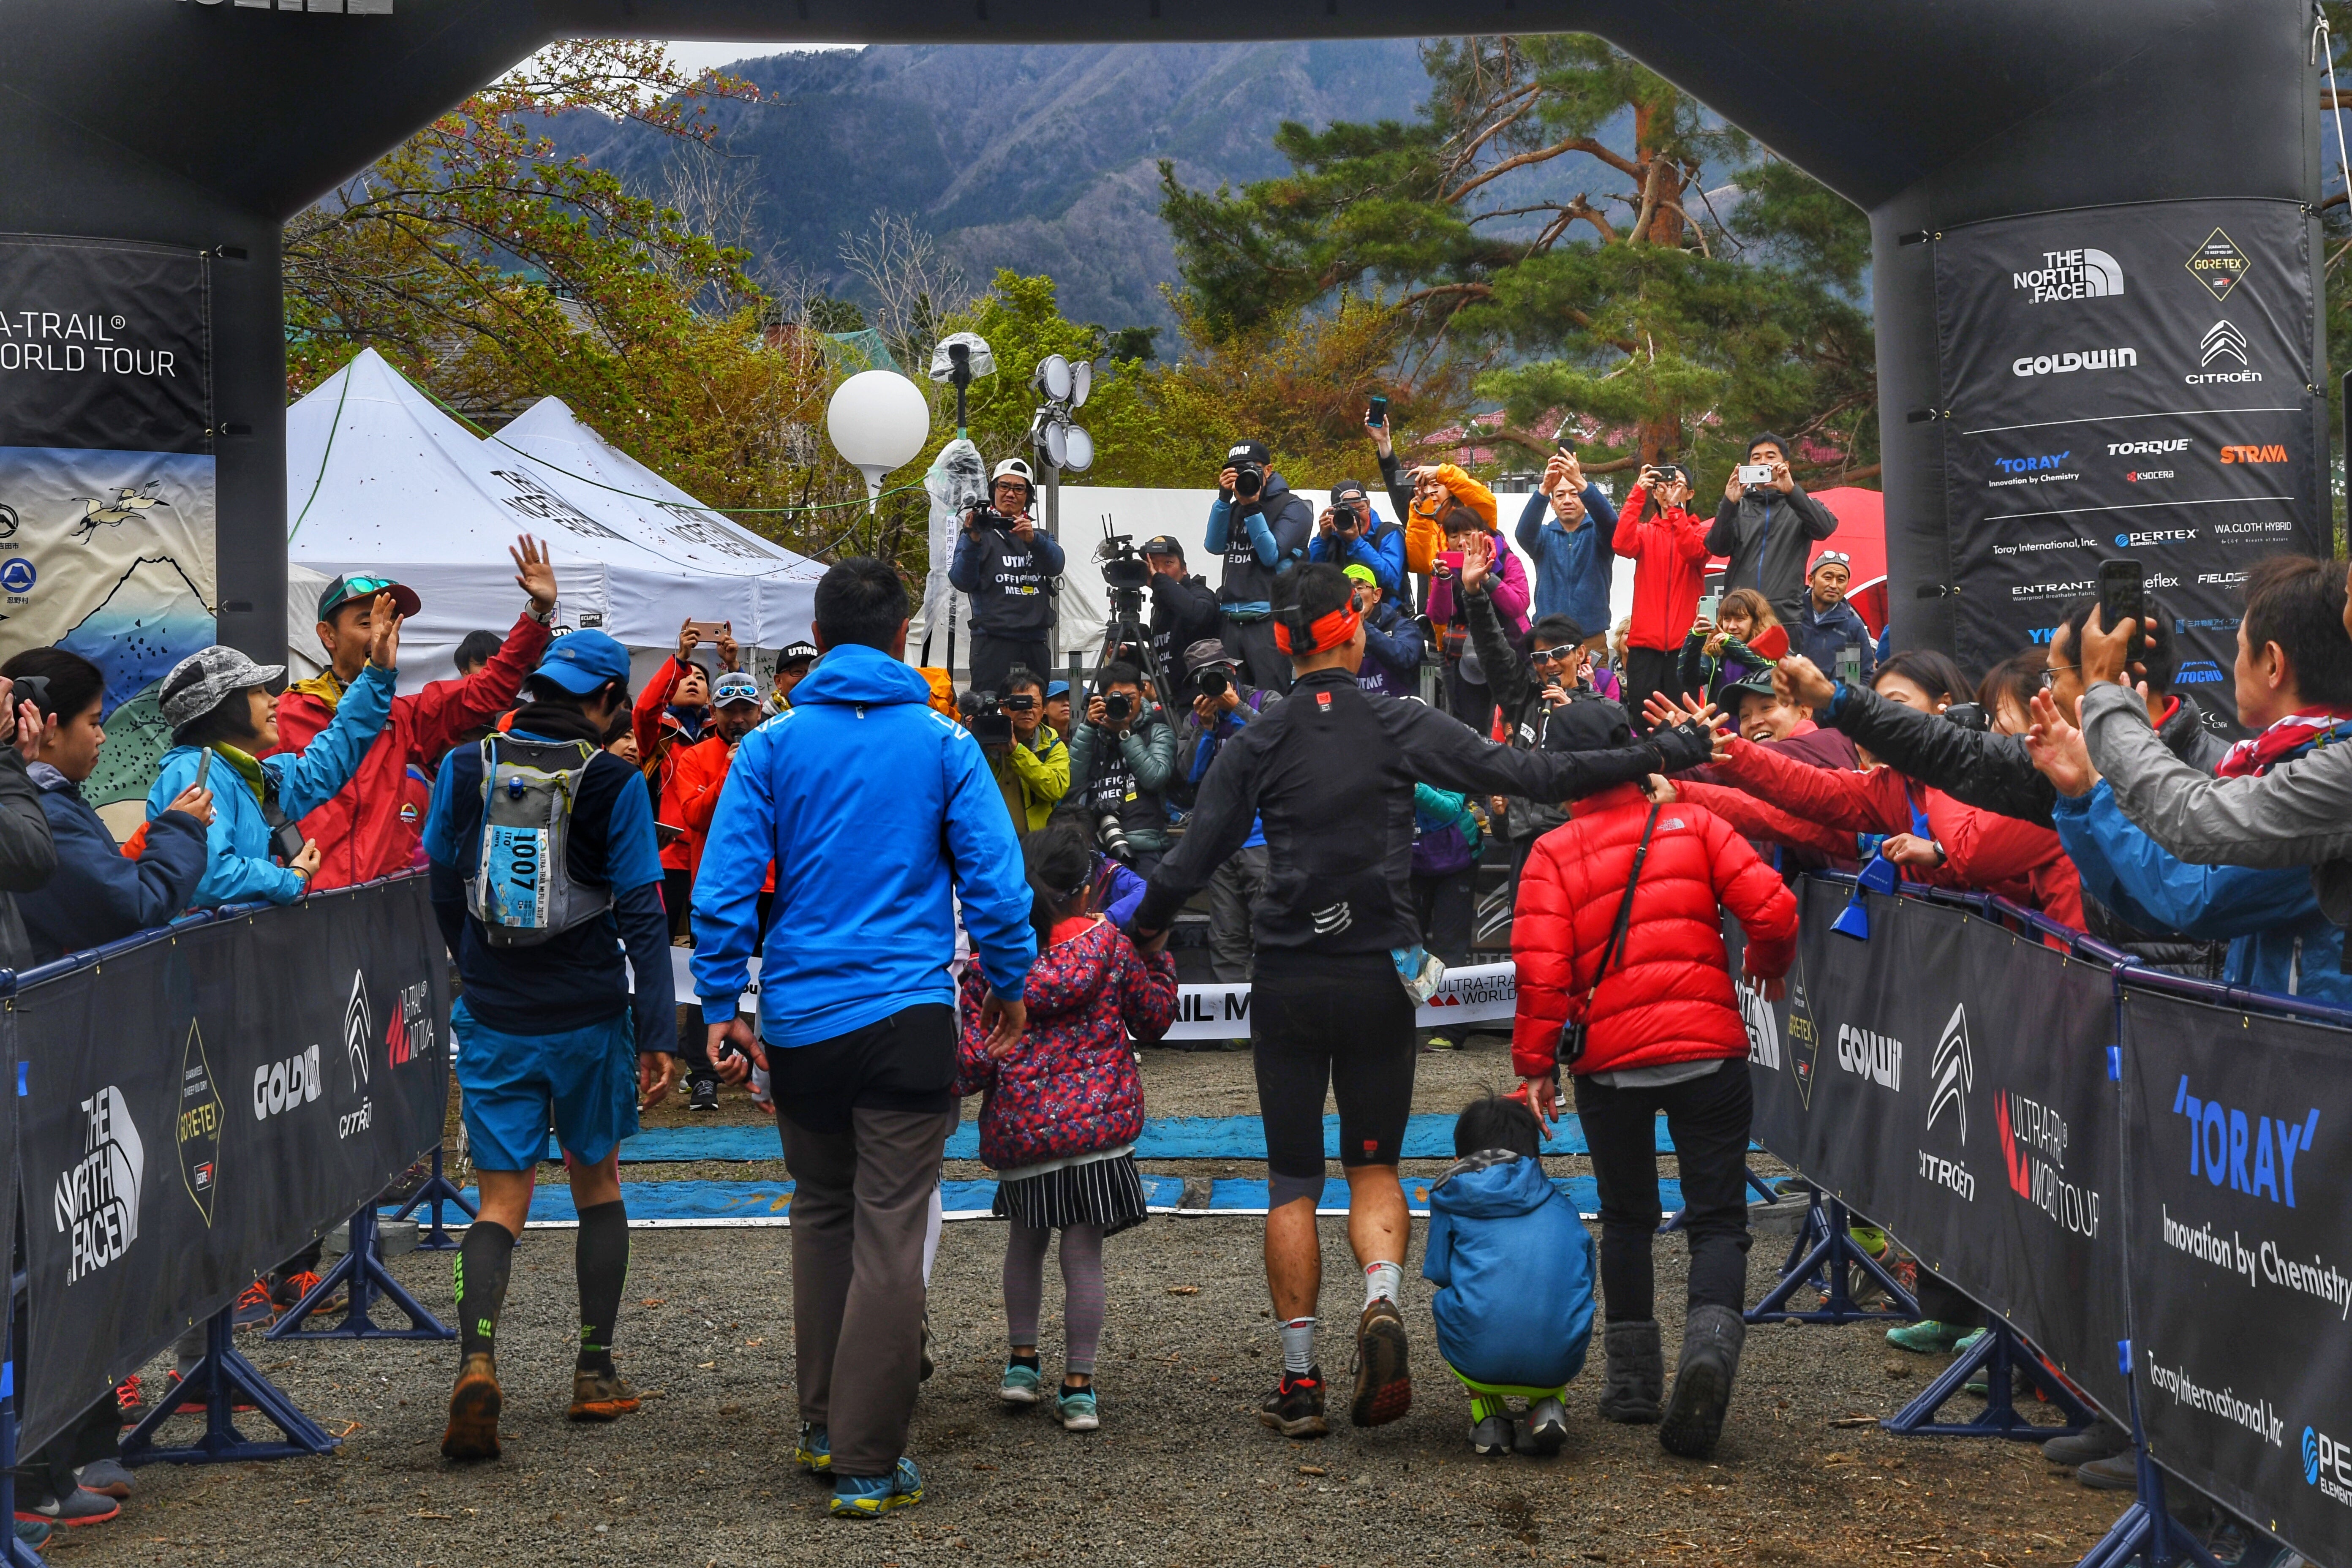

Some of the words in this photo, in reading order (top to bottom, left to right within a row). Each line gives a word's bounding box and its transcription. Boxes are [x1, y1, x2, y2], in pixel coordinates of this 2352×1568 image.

[2043, 249, 2083, 268] THE
[2194, 259, 2241, 270] GORE-TEX
[2013, 266, 2084, 289] NORTH
[2034, 282, 2085, 303] FACE
[1, 343, 84, 371] ORLD
[95, 346, 175, 377] TOUR
[1228, 446, 1250, 458] UTMF
[2107, 438, 2189, 455] TORQUE
[2220, 444, 2288, 464] STRAVA
[1989, 478, 2027, 487] Innovation
[2029, 476, 2038, 484] by
[2040, 473, 2080, 482] Chemistry
[2137, 470, 2174, 480] KYOCERA
[2130, 529, 2196, 542] PERTEX
[2265, 522, 2292, 531] HYBRID
[1993, 545, 2017, 555] Toray
[2081, 538, 2098, 547] Inc.
[1228, 553, 1251, 563] EDIA
[2012, 581, 2095, 594] ENTRANT
[2143, 572, 2178, 588] eflex
[2028, 628, 2058, 644] YK
[788, 646, 818, 656] UTMF
[2175, 670, 2224, 683] ITOCHU
[504, 832, 512, 846] ITO
[510, 834, 536, 891] 1007
[1176, 994, 1214, 1022] IL
[81, 1087, 110, 1154] THE
[180, 1101, 216, 1143] GORE-TEX
[54, 1145, 113, 1233] NORTH
[72, 1203, 121, 1282] FACE
[2163, 1203, 2231, 1269] Innovation
[2235, 1230, 2255, 1288] by
[2261, 1240, 2352, 1320] Chemistry
[2148, 1350, 2180, 1405] Toray
[2319, 1432, 2352, 1487] PE
[2321, 1477, 2352, 1507] ELEMENT
